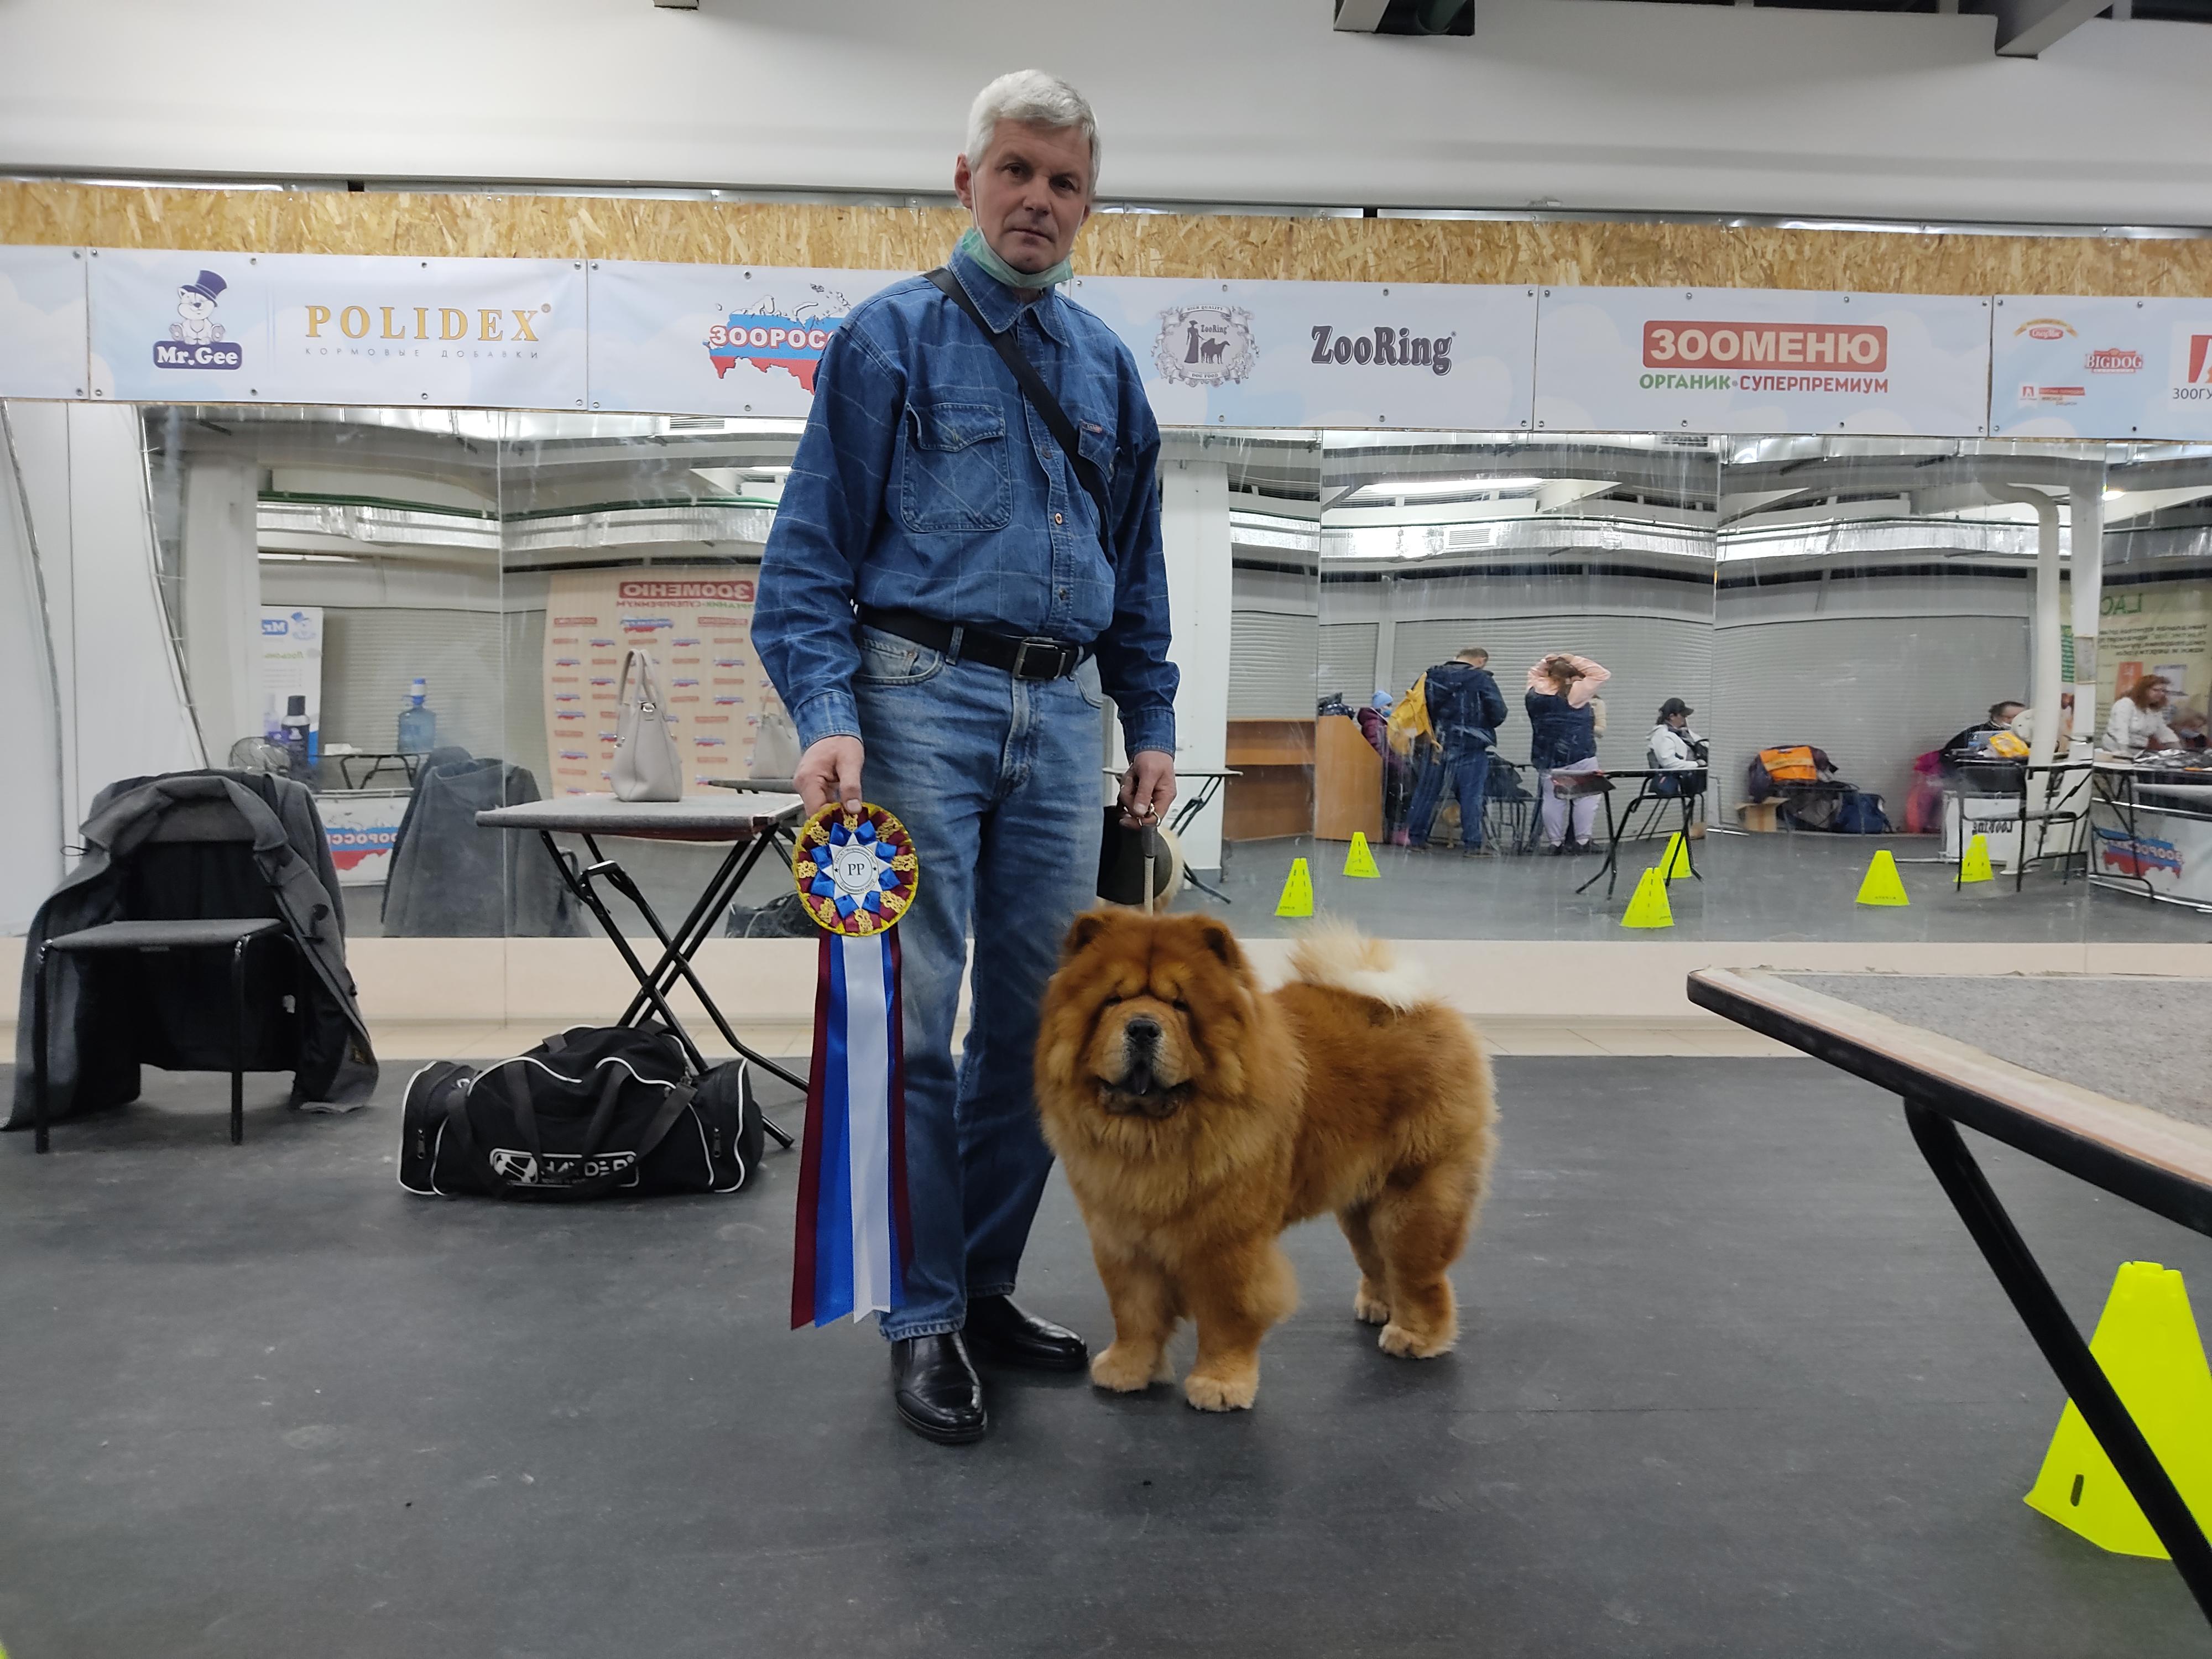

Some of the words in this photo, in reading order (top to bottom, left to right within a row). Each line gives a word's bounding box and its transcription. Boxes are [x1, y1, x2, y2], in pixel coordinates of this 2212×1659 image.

[709, 325, 834, 351] ЗООРОС
[1201, 324, 1228, 336] ZooRing
[306, 348, 419, 357] КОРМОВЫЕ
[441, 349, 538, 358] ДОБАВКИ
[1311, 326, 1453, 376] ZooRing
[1650, 328, 1880, 365] ЗООМЕНЮ
